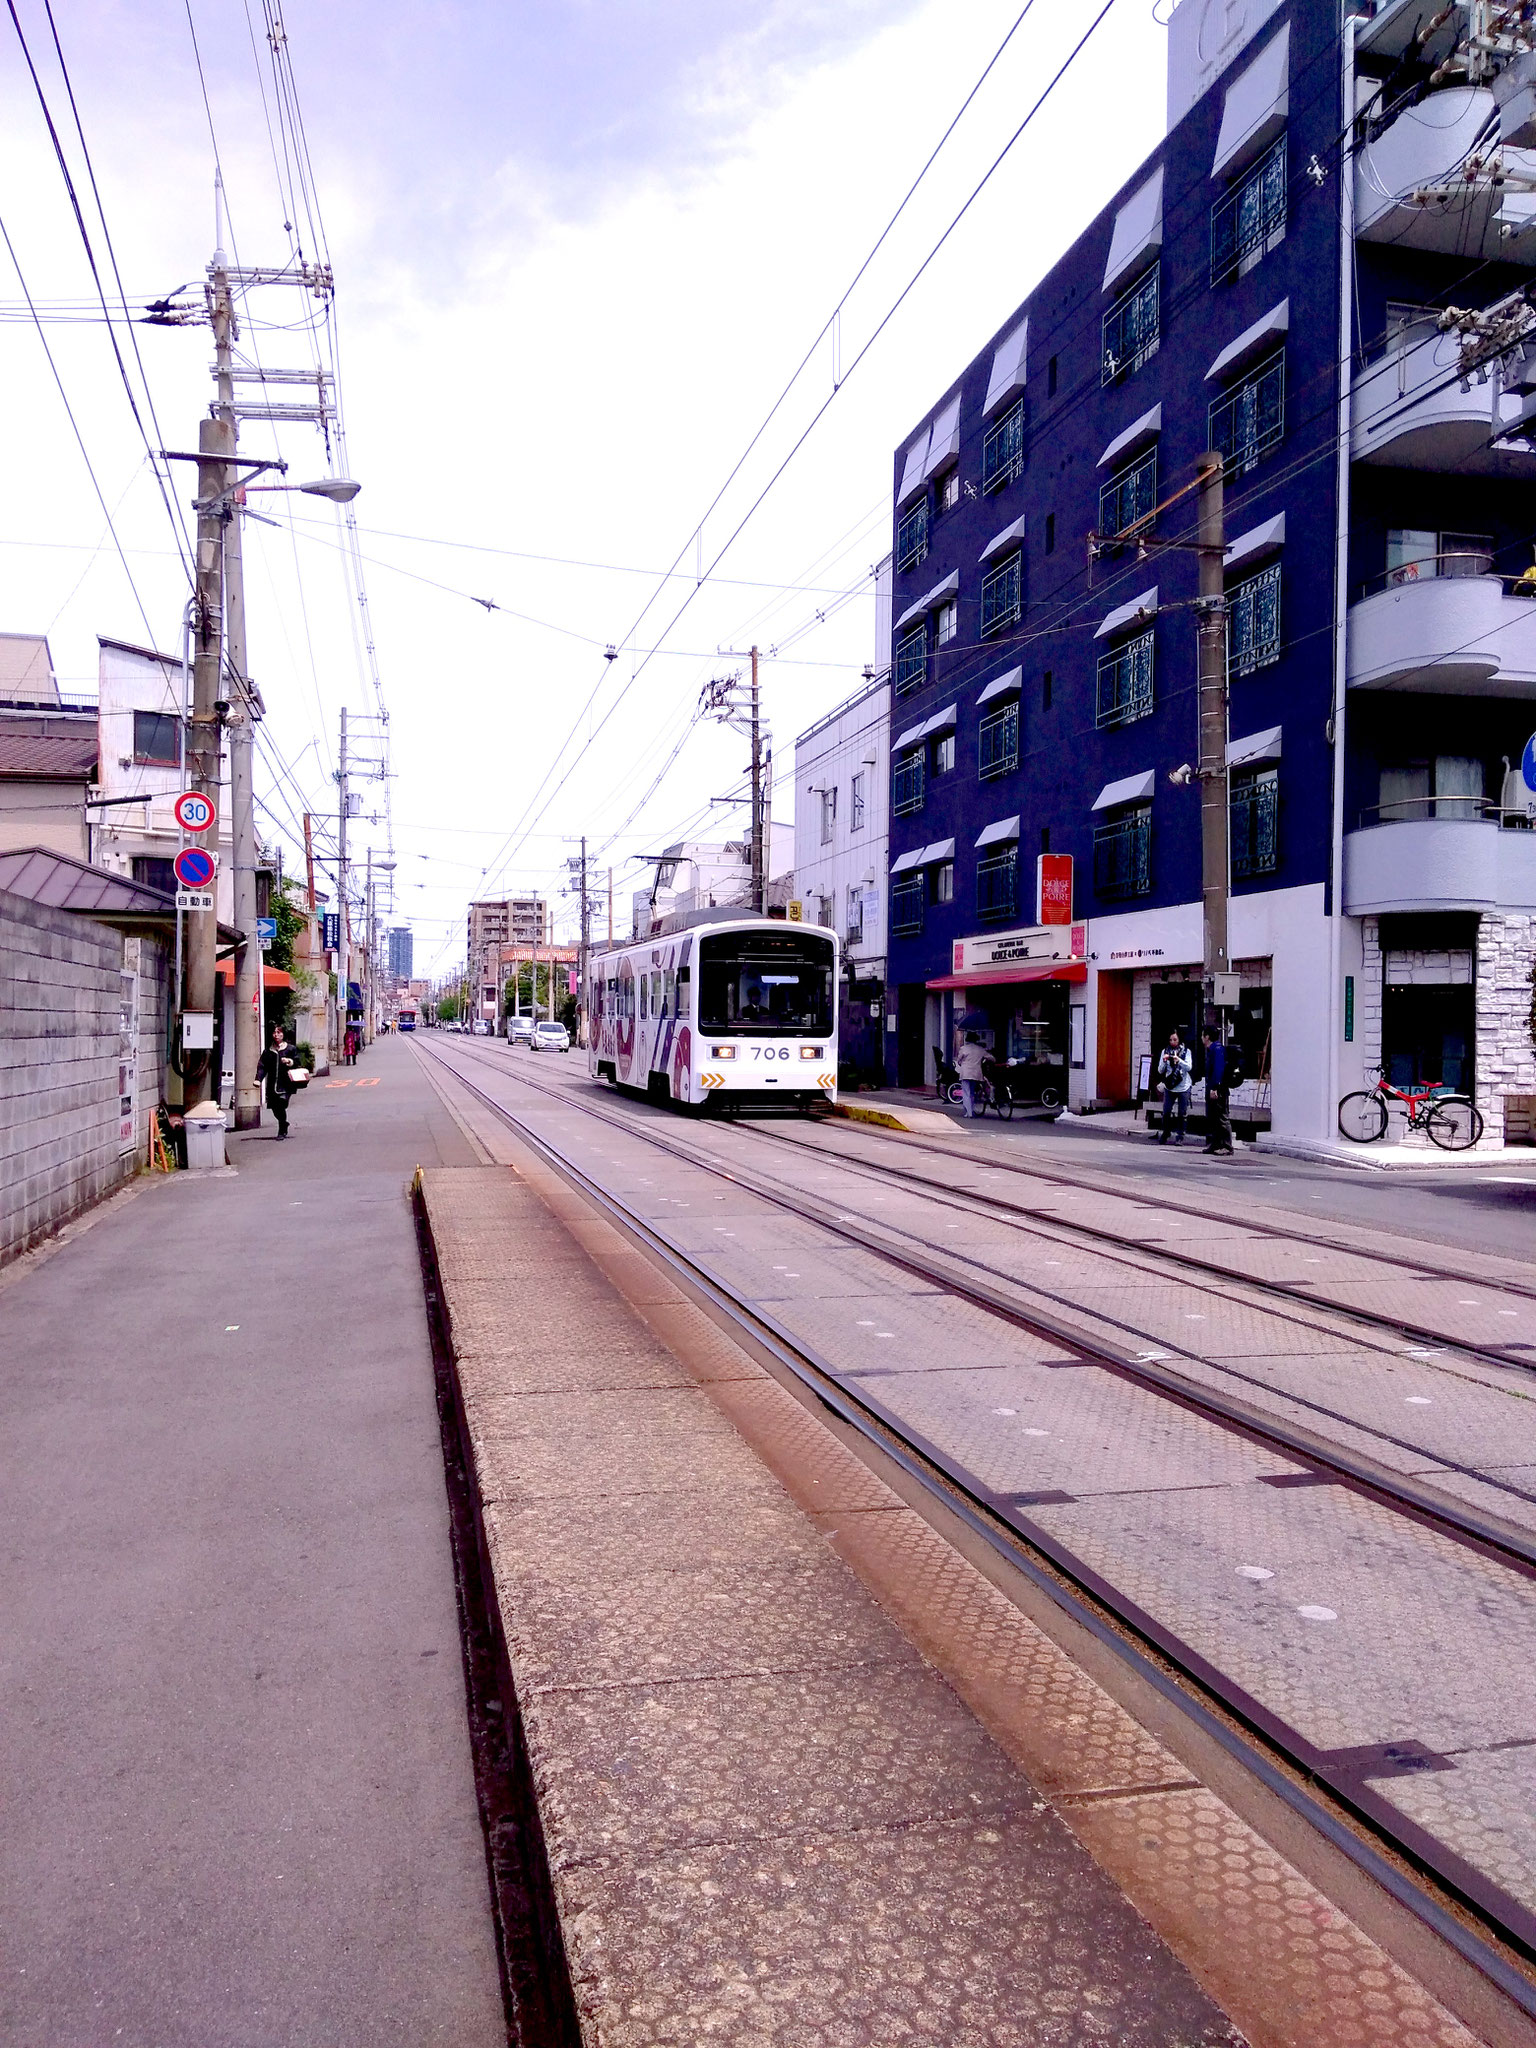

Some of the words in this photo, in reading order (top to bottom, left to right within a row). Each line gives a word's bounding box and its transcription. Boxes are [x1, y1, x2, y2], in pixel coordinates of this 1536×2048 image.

[184, 803, 207, 821] 30
[178, 896, 212, 906] 自動車
[1043, 893, 1071, 901] POIRE
[750, 1047, 790, 1060] 706
